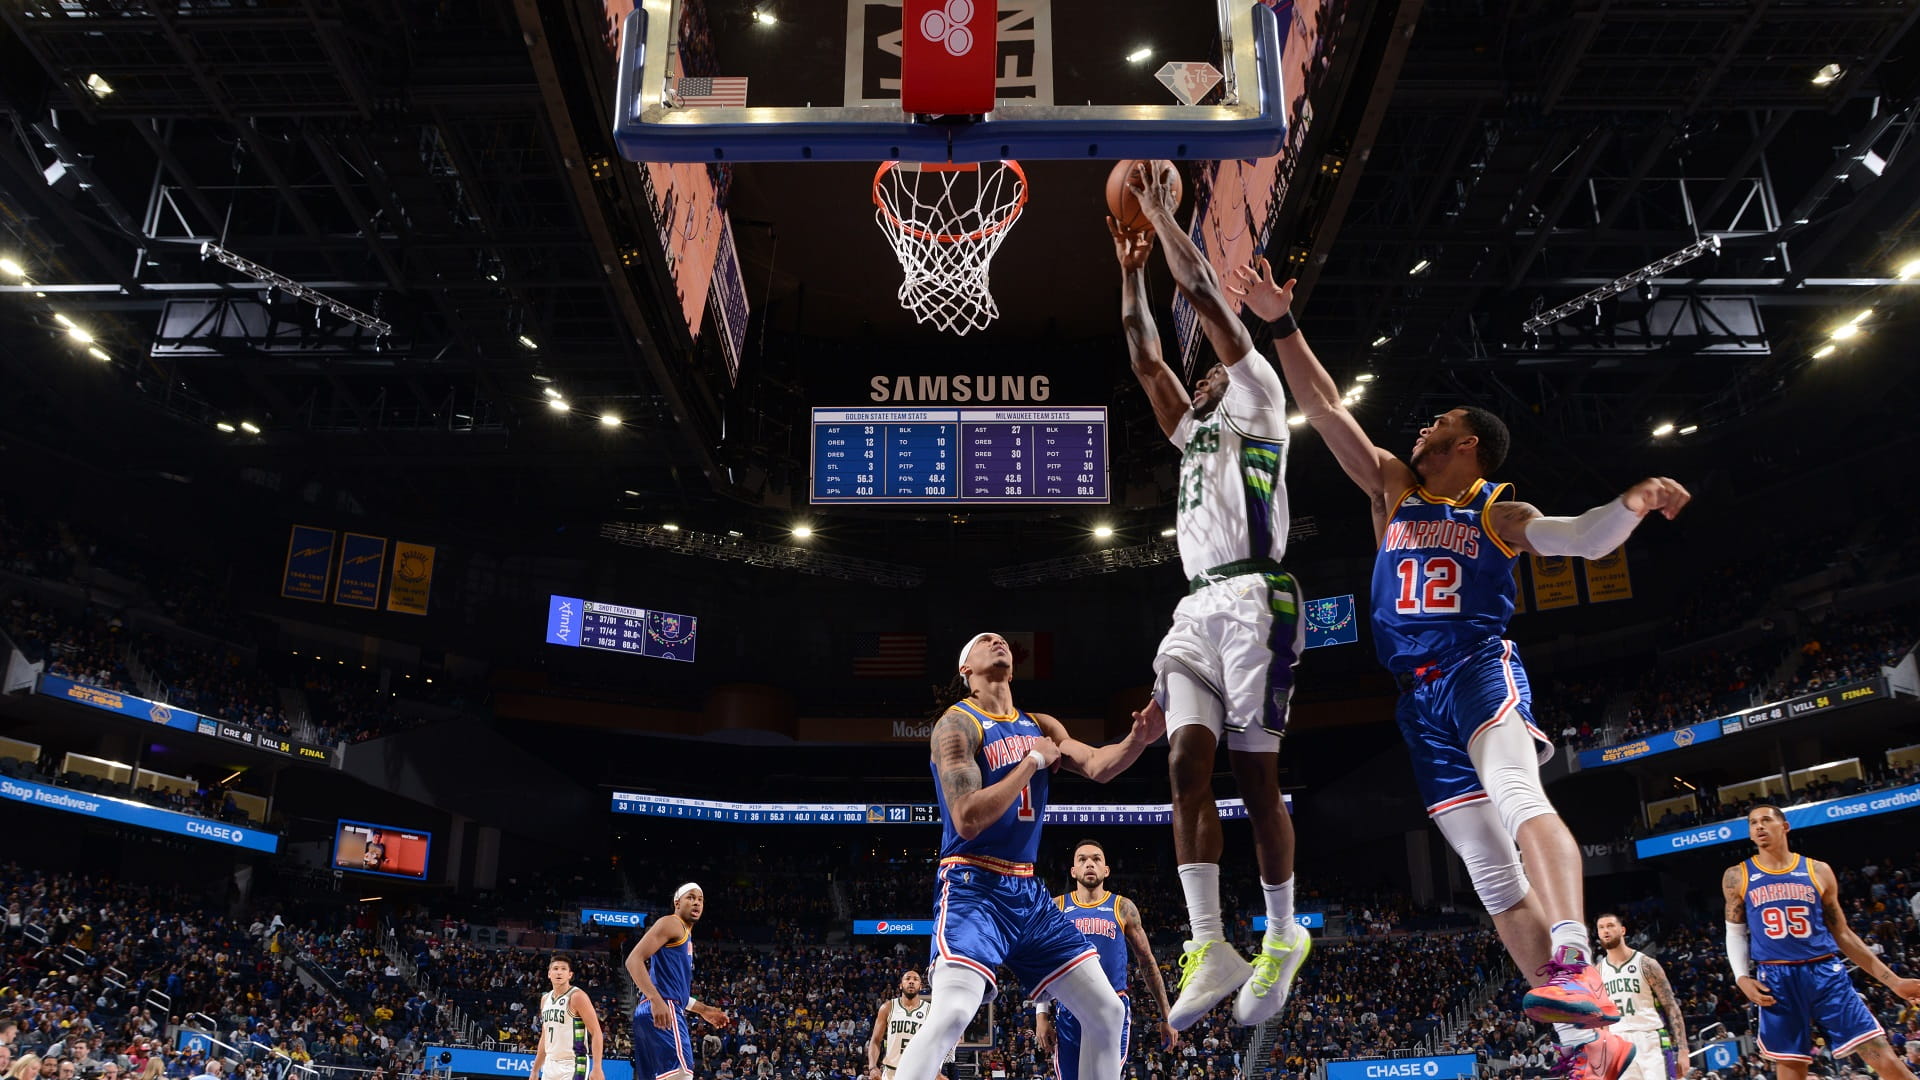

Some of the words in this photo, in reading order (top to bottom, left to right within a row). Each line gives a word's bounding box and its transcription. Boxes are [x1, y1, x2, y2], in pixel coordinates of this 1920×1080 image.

[1194, 69, 1208, 83] 75
[870, 375, 1050, 402] SAMSUNG
[890, 412, 907, 420] TEAM
[908, 412, 928, 420] STATS
[996, 412, 1032, 420] MILWAUKEE
[1033, 412, 1050, 420] TEAM
[1050, 412, 1070, 420] STATS
[864, 426, 874, 434] 33
[1012, 426, 1021, 434] 27
[866, 438, 874, 446] 12
[937, 438, 946, 446] 10
[864, 450, 874, 458] 43
[1012, 450, 1021, 458] 30
[1085, 450, 1093, 458] 17
[936, 462, 946, 470] 36
[1084, 462, 1093, 470] 30
[857, 474, 873, 482] 56.3
[929, 474, 946, 483] 48.4
[1005, 474, 1022, 482] 42.6
[1077, 474, 1094, 482] 40.7
[856, 486, 873, 495] 40.0
[925, 486, 946, 495] 100.0
[1005, 487, 1022, 495] 38.6
[1078, 487, 1094, 495] 69.6
[1385, 519, 1481, 559] WARRIORS
[1396, 557, 1462, 615] 12
[598, 604, 612, 612] SHOT
[614, 606, 637, 616] TRACKER
[557, 601, 574, 642] xfinity
[600, 627, 617, 636] 17/44
[1841, 686, 1874, 701] FINAL
[1792, 701, 1815, 714] VILL
[1816, 696, 1829, 709] 54
[1748, 712, 1768, 724] CRE
[1770, 708, 1782, 719] 48
[224, 727, 240, 738] CRE
[242, 732, 252, 742] 48
[262, 736, 279, 749] VILL
[280, 742, 290, 752] 54
[300, 747, 326, 760] FINAL
[1, 781, 33, 800] Shop
[35, 790, 100, 813] headwear
[1017, 778, 1035, 822] 1
[619, 802, 627, 810] 33
[639, 804, 646, 812] 12
[657, 806, 666, 814] 43
[1218, 808, 1233, 816] 38.6
[1826, 801, 1868, 818] Chase
[889, 808, 906, 820] 121
[1043, 814, 1050, 822] 27
[1080, 814, 1088, 822] 30
[1155, 814, 1162, 822] 17
[186, 821, 230, 839] CHASE
[1671, 829, 1717, 848] CHASE
[1748, 883, 1816, 908] WARRIORS
[593, 913, 629, 923] CHASE
[1761, 906, 1812, 940] 95
[890, 923, 914, 932] pepsi
[548, 1026, 554, 1044] 7
[1366, 1063, 1421, 1078] CHASE
